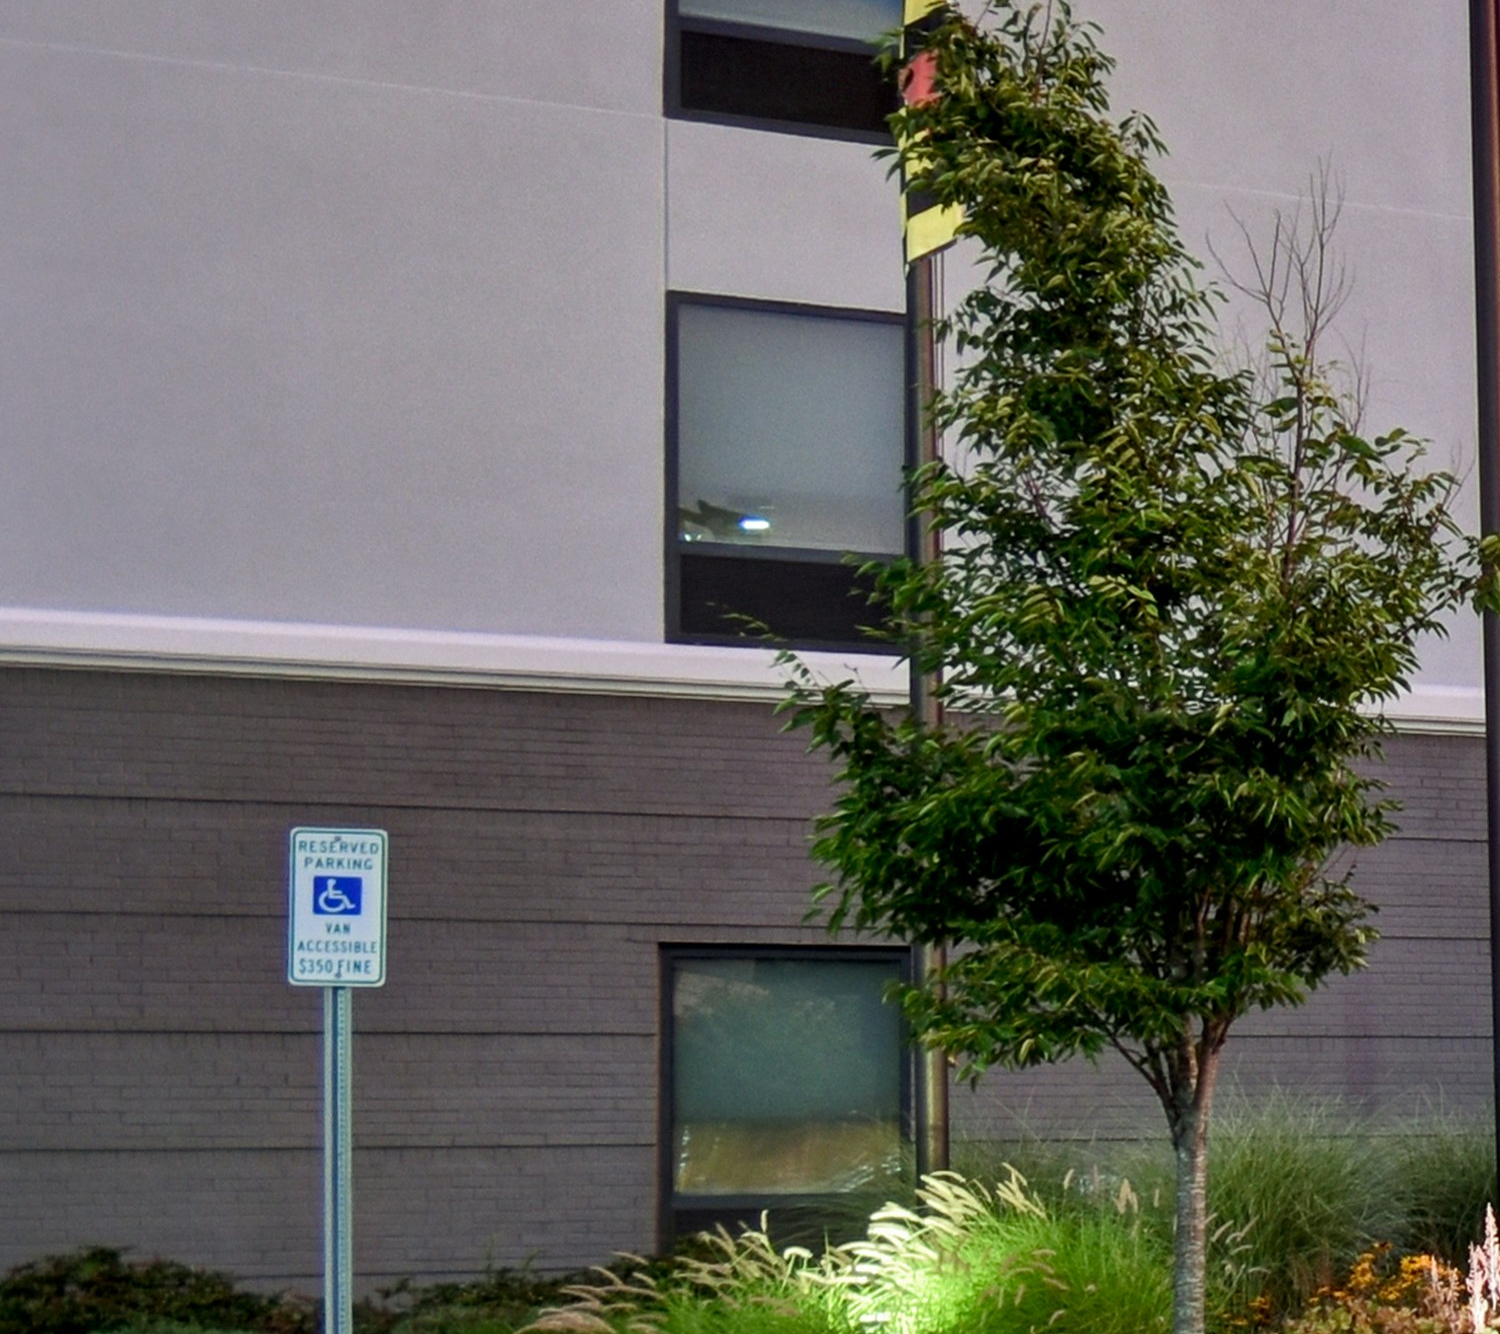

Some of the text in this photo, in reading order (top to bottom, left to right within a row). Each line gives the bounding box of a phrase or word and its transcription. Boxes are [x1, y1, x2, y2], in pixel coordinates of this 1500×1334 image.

[298, 839, 379, 855] RESERVED
[304, 857, 373, 871] PARKING
[325, 922, 351, 934] VAN
[297, 940, 377, 954] ACCESSIBLE
[299, 958, 371, 975] $350 FINE
